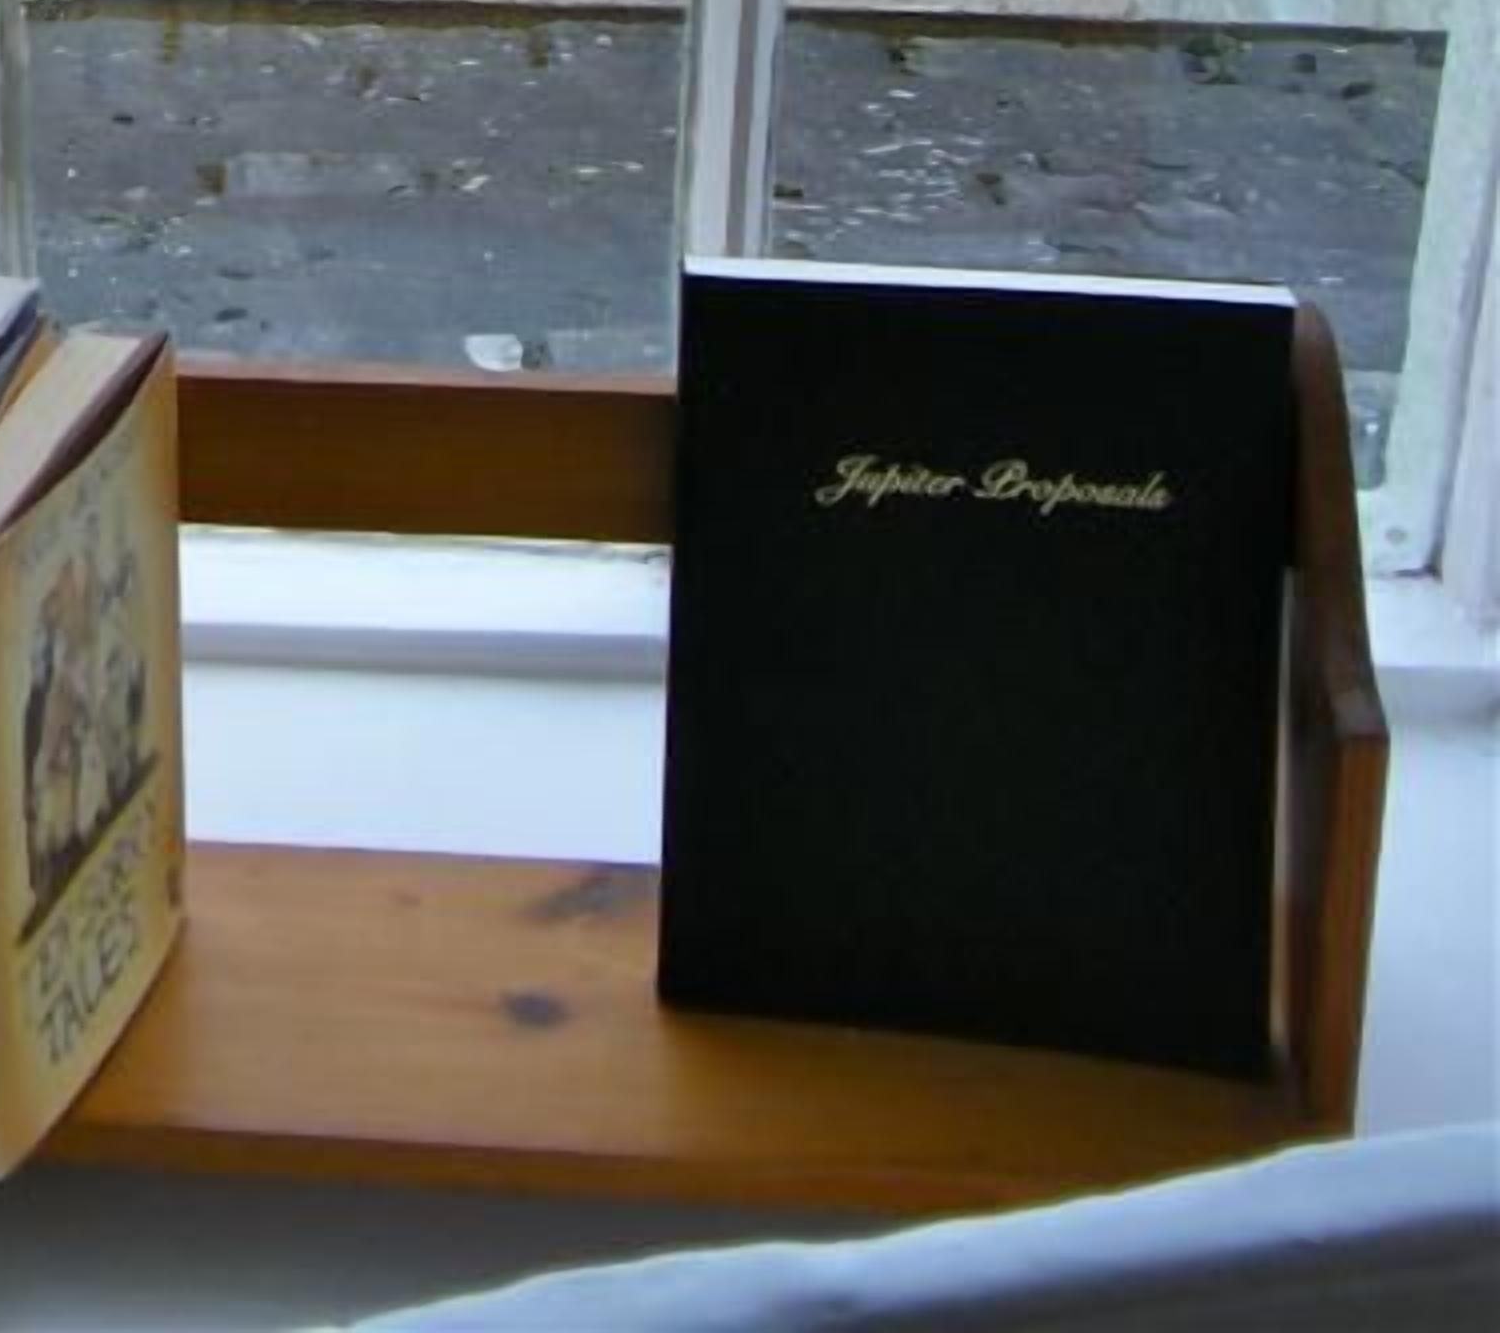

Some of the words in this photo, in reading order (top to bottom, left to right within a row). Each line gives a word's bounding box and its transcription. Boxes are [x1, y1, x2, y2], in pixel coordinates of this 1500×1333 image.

[816, 454, 961, 509] Jupiter
[976, 459, 1172, 514] Proposals
[41, 908, 142, 1064] TALES
